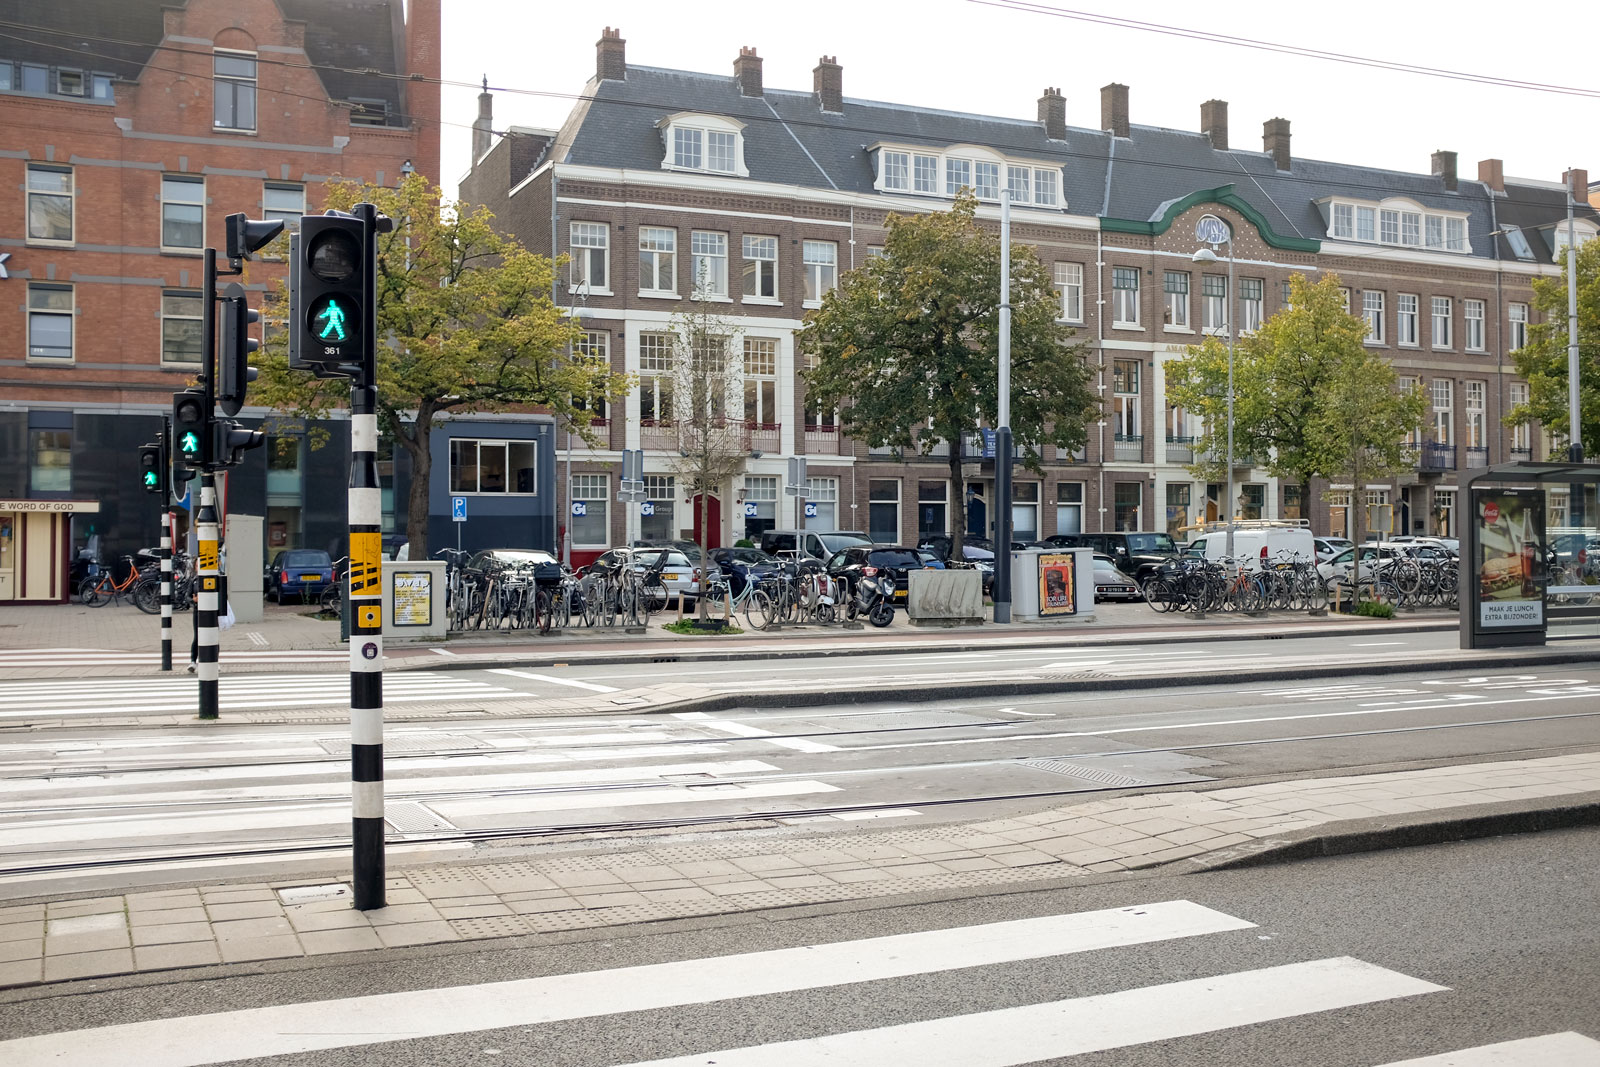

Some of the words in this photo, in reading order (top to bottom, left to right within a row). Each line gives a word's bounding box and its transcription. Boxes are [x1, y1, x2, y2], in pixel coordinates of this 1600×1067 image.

[325, 347, 340, 355] 361
[39, 503, 52, 511] OF
[54, 503, 74, 511] GOD
[456, 499, 464, 510] P
[655, 505, 672, 513] Group
